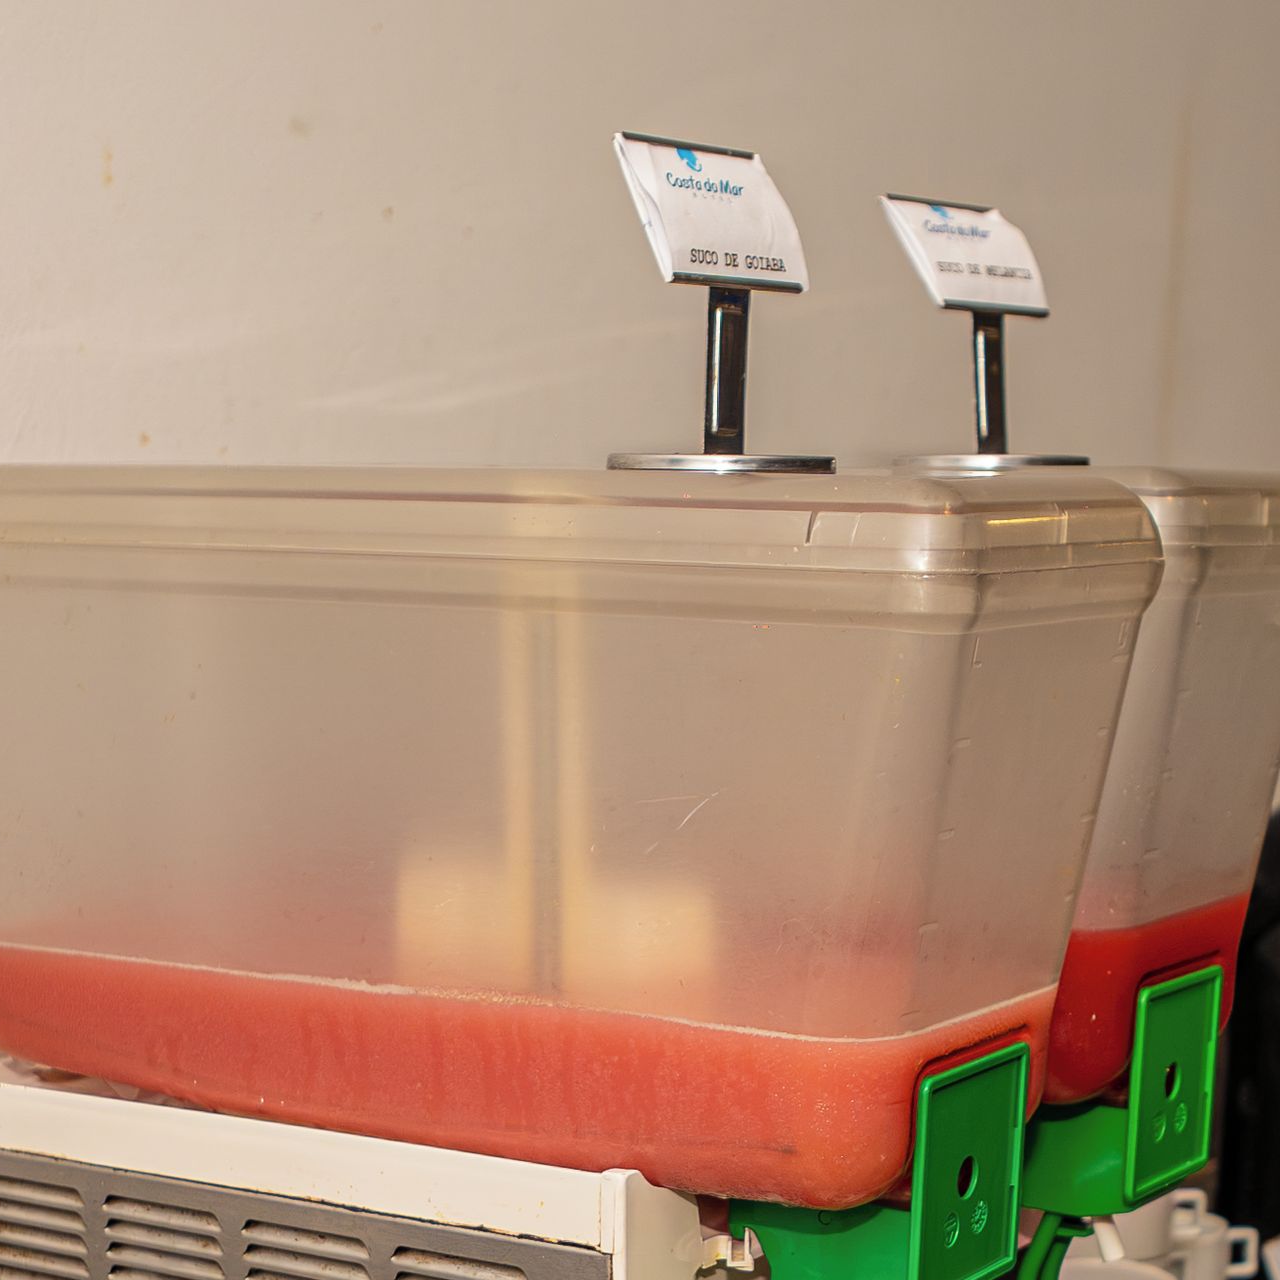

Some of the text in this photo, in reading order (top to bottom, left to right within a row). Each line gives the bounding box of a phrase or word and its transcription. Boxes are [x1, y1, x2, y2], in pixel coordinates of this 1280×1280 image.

[666, 172, 744, 196] Costa do Mar
[690, 248, 787, 273] SUCO DE GOIABA
